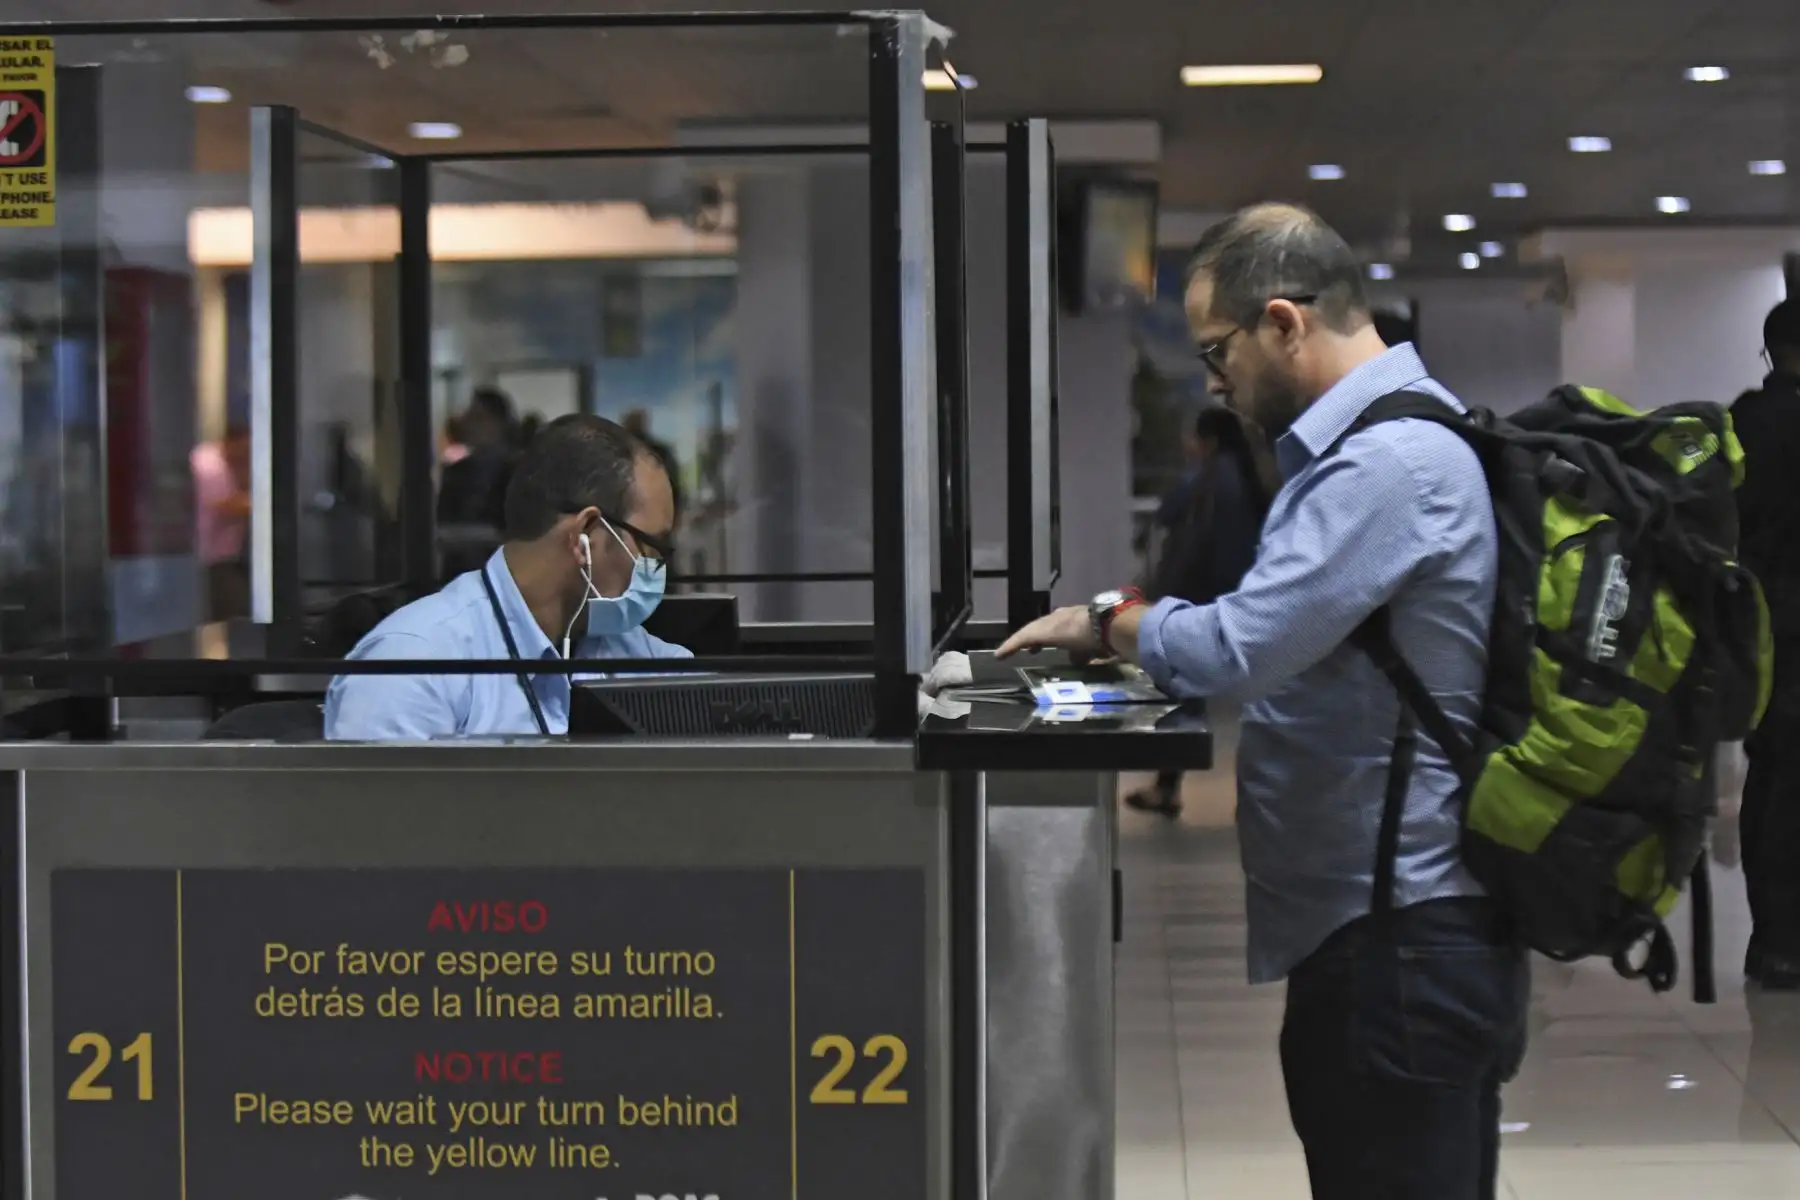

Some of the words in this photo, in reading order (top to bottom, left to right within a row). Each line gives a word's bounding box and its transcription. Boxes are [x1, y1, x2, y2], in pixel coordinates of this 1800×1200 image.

[0, 39, 32, 51] SAR
[36, 39, 53, 50] EL
[0, 56, 45, 68] ULAR.
[18, 172, 48, 185] USE
[0, 208, 39, 219] EASE
[428, 899, 549, 933] AVISO
[264, 941, 325, 976] Por
[336, 943, 422, 976] favor
[436, 950, 558, 982] espere
[570, 950, 612, 977] su
[623, 944, 716, 977] turno
[255, 985, 366, 1018] detrás
[376, 987, 421, 1018] de
[432, 987, 463, 1019] la
[474, 985, 561, 1019] línea
[573, 986, 724, 1019] amarilla.
[67, 1031, 154, 1102] 21
[415, 1050, 564, 1084] NOTICE
[809, 1033, 910, 1105] 22
[234, 1091, 355, 1126] Please
[365, 1093, 437, 1126] wait
[447, 1100, 527, 1134] your
[537, 1097, 606, 1127] turn
[617, 1094, 739, 1127] behind
[360, 1136, 416, 1168] the
[426, 1136, 538, 1176] yellow
[549, 1136, 621, 1169] line.
